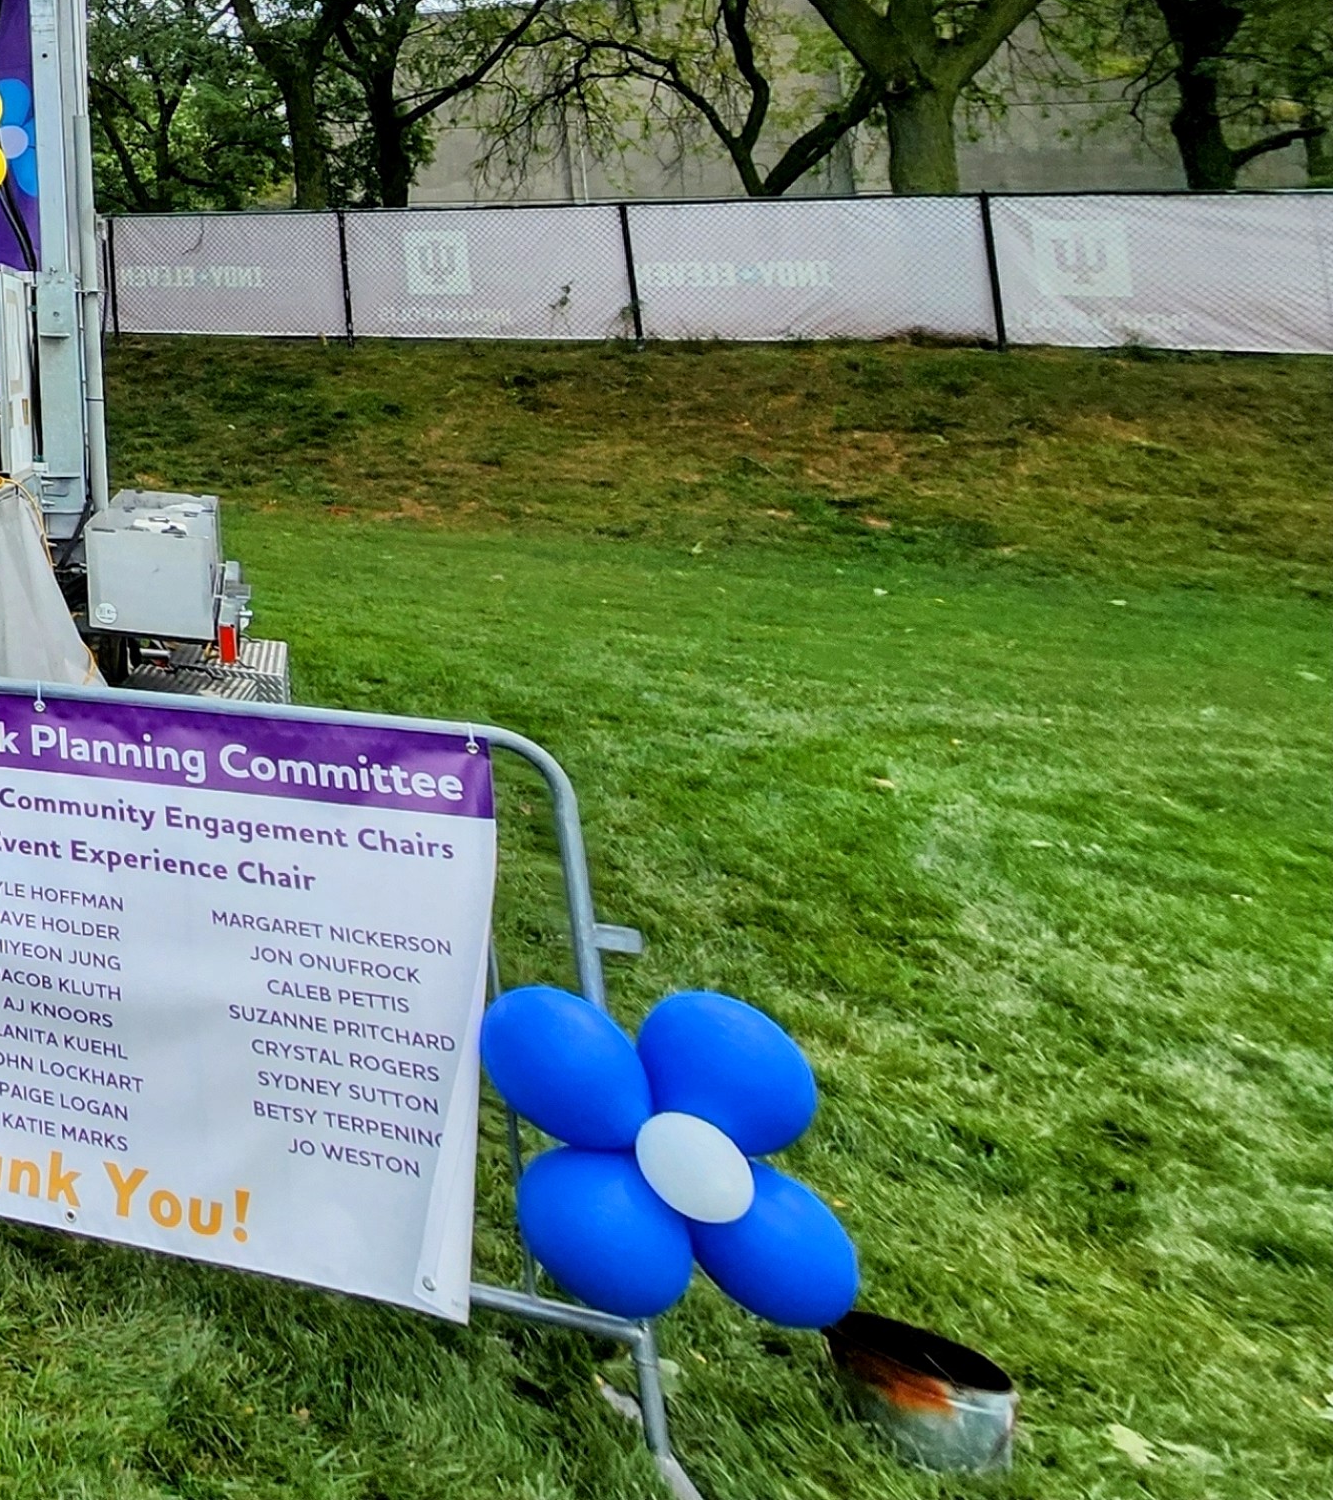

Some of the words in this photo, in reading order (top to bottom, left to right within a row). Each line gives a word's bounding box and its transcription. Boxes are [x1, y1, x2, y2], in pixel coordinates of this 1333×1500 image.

[31, 724, 206, 784] Planning
[219, 744, 464, 800] Committee
[165, 806, 348, 848] Engagement
[358, 828, 454, 859] Chairs
[71, 840, 228, 880] Experience
[237, 860, 316, 891] Chair
[31, 885, 124, 912] HOFFMAN
[41, 916, 121, 942] HOLDER
[211, 909, 323, 939] MARGARET
[330, 925, 452, 956] NICKERSON
[68, 949, 121, 971] JUNG
[249, 946, 293, 966] JON
[299, 953, 421, 984] ONUFROCK
[58, 977, 122, 1002] KLUTH
[267, 979, 332, 1002] CALEB
[337, 988, 410, 1013] PETTIS
[3, 996, 24, 1012] AJ
[31, 1000, 114, 1028] KNOORS
[229, 1004, 328, 1034] SUZANNE
[333, 1018, 456, 1052] PRITCHARD
[64, 1034, 129, 1060] KUEHL
[251, 1038, 344, 1067] CRYSTAL
[349, 1052, 440, 1082] ROGERS
[39, 1059, 144, 1093] LOCKHART
[257, 1071, 342, 1097] SYDNEY
[348, 1084, 440, 1116] SUTTON
[0, 1081, 54, 1105] PAIGE
[60, 1093, 129, 1122] LOGAN
[253, 1100, 318, 1125] BETSY
[2, 1111, 55, 1137] KATIE
[61, 1124, 129, 1152] MARKS
[288, 1138, 316, 1156] JO
[321, 1142, 421, 1178] WESTON
[103, 1161, 250, 1243] You!
